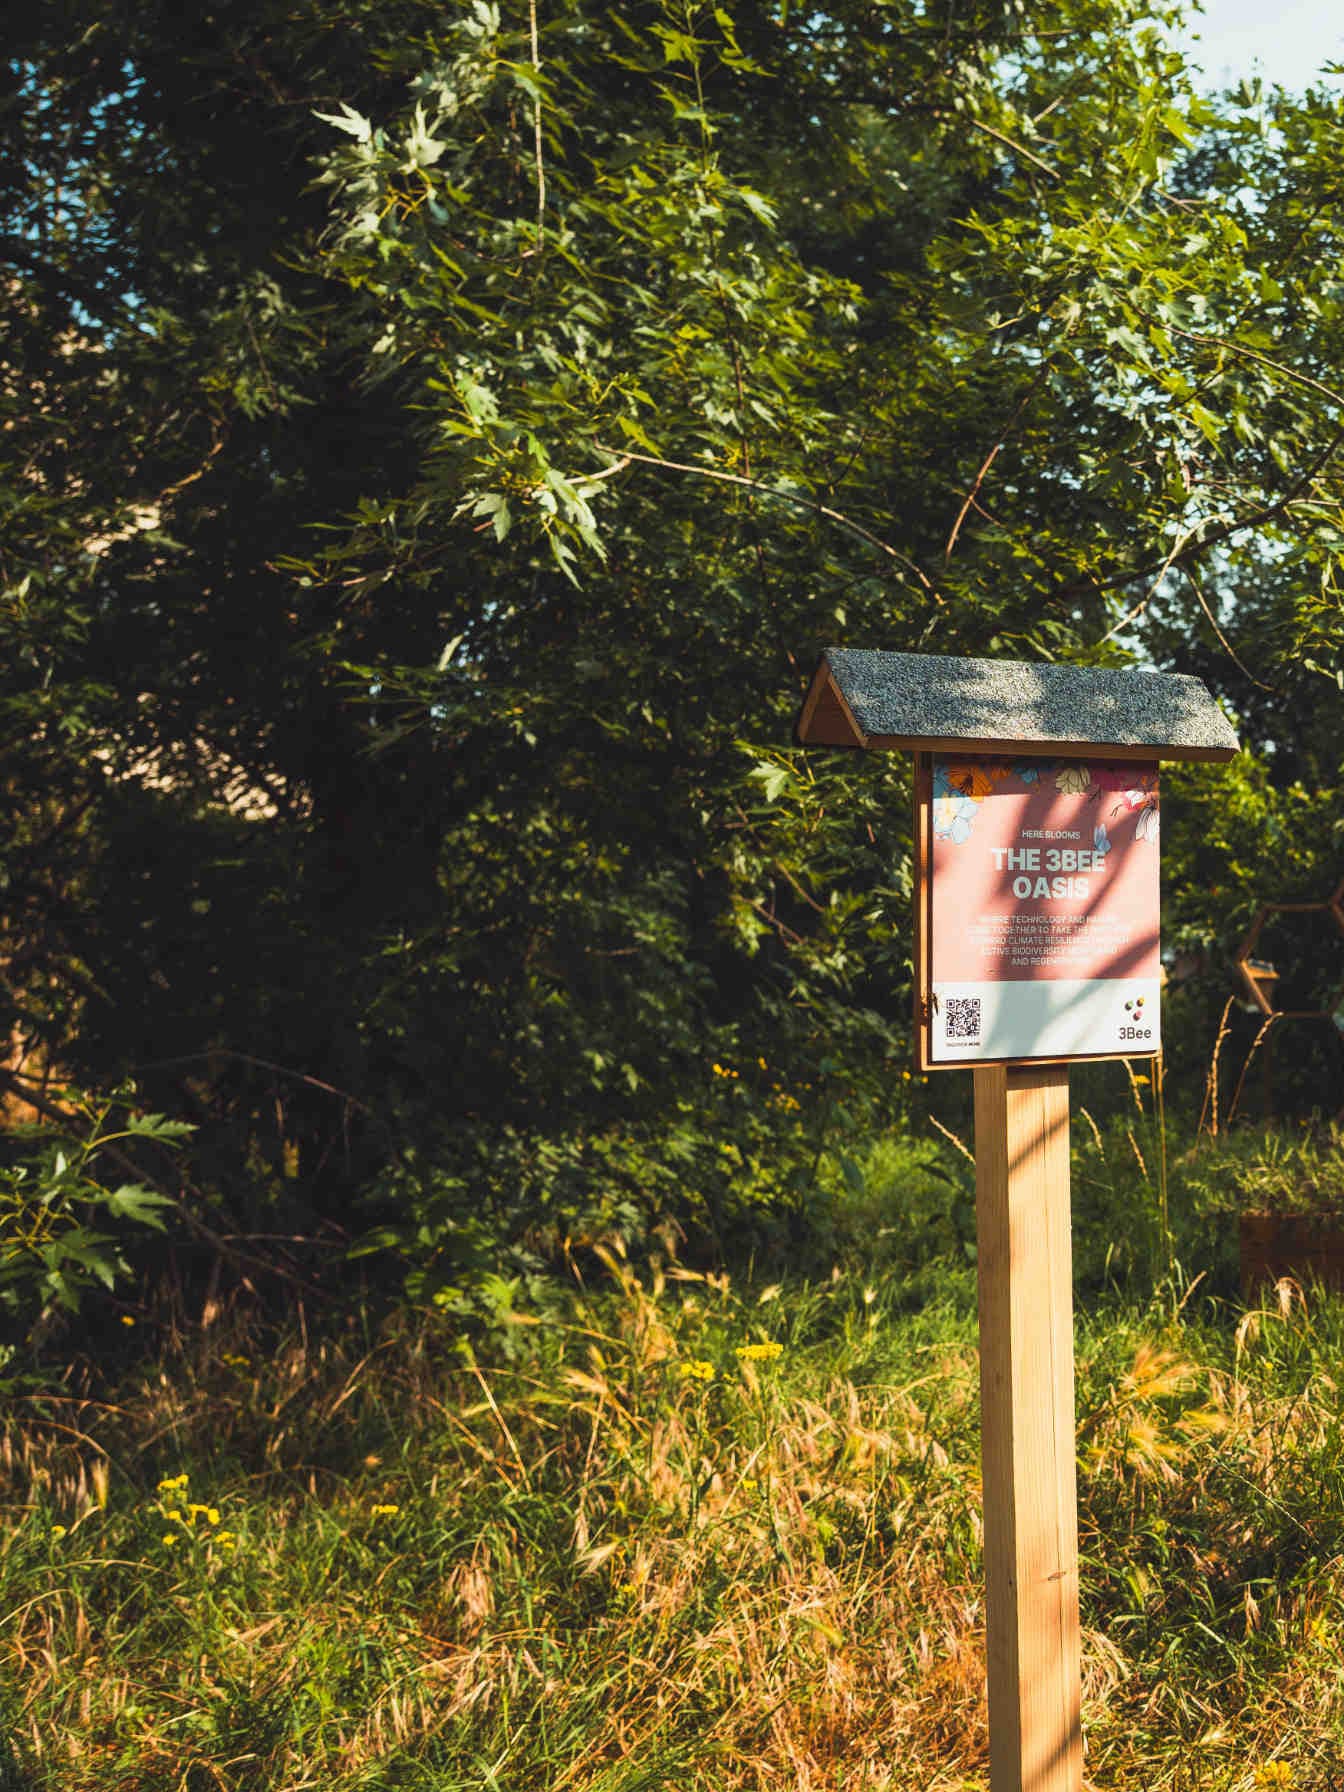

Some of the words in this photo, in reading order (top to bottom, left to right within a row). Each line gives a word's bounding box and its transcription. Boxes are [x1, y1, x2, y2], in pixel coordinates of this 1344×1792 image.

[1022, 830, 1045, 839] HERE
[1046, 830, 1081, 840] BLOOMS
[991, 848, 1041, 871] THE
[1045, 848, 1106, 872] 3BEE
[1013, 876, 1090, 899] OASIS
[1010, 915, 1066, 924] TECHNOLOGY
[1119, 1026, 1152, 1040] 3Bee
